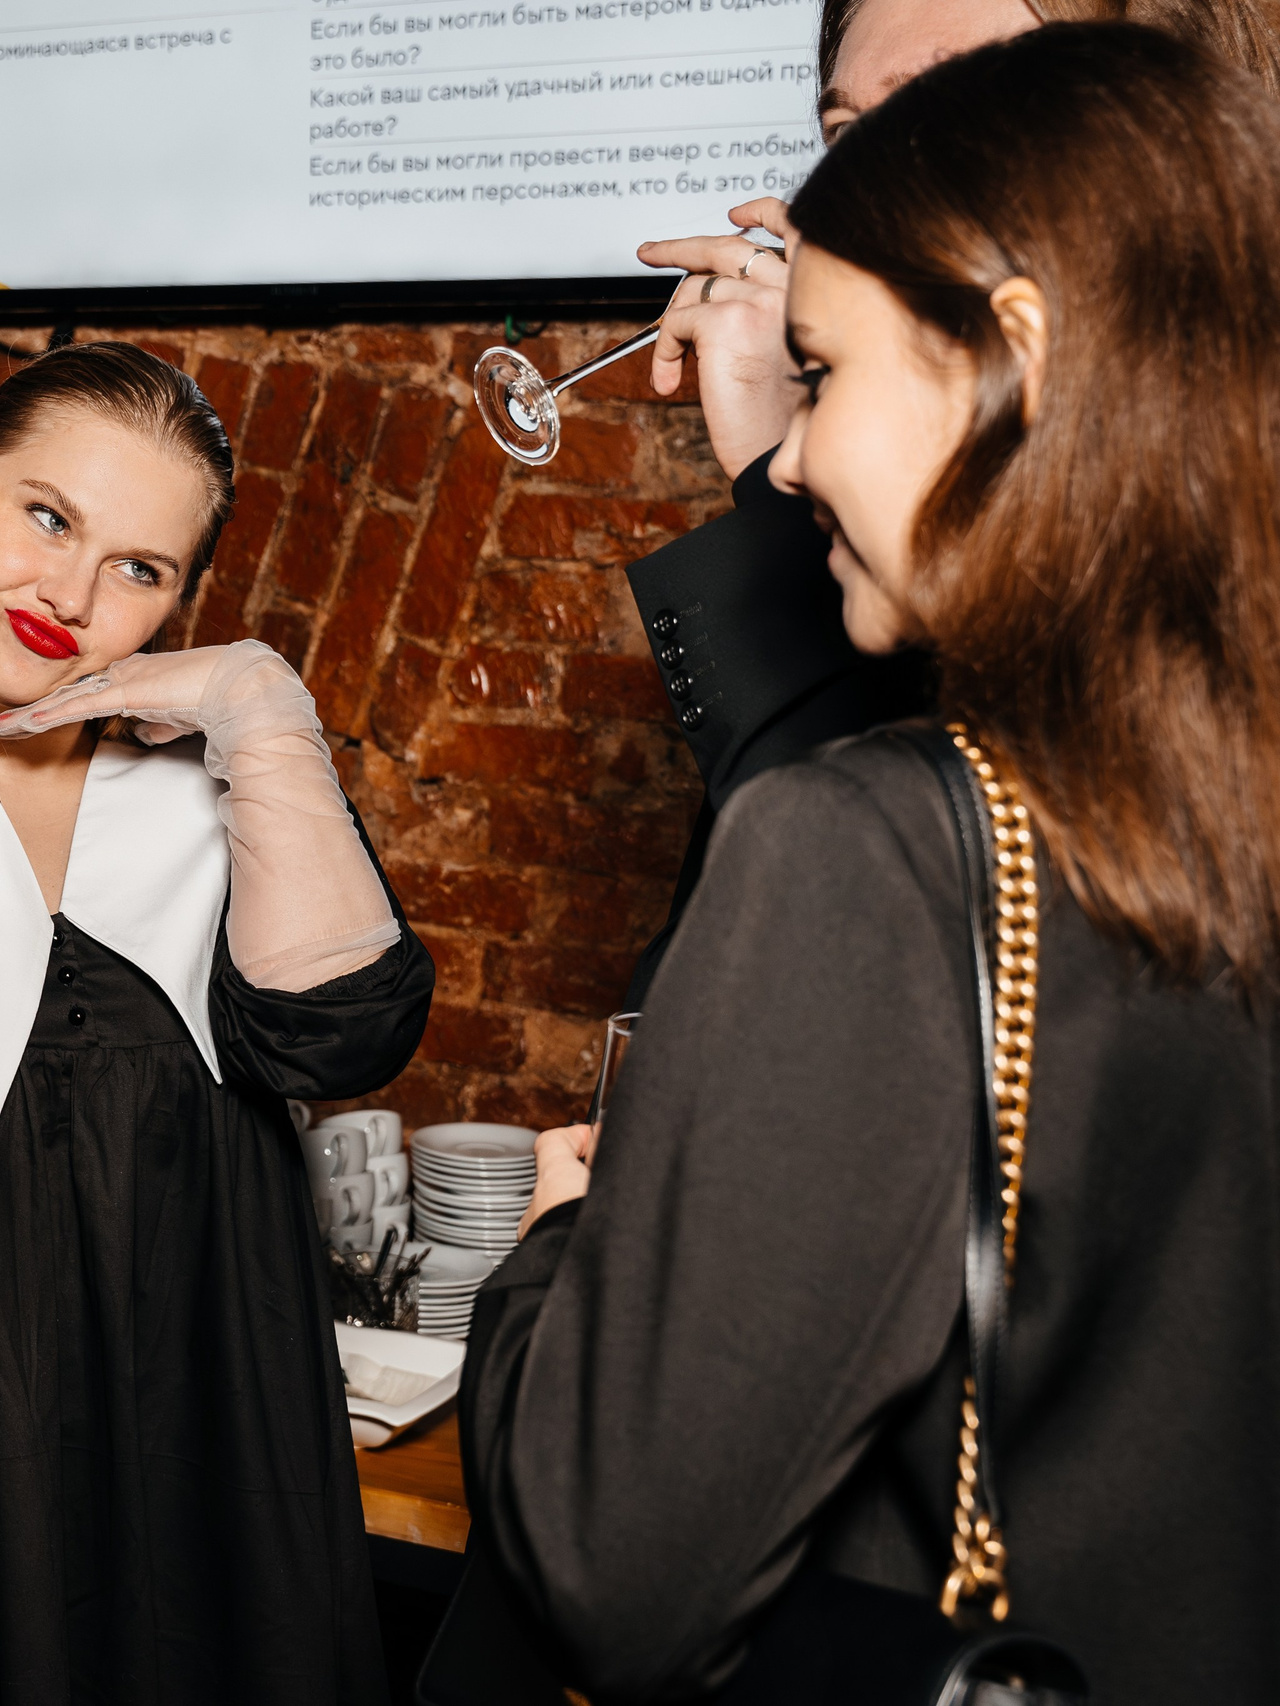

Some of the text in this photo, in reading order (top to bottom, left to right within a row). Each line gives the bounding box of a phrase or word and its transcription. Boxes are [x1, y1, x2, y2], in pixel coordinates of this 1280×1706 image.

[311, 19, 364, 40] Если
[369, 14, 398, 35] бы
[405, 17, 432, 33] вы
[439, 11, 507, 30] могли
[512, 4, 569, 25] быть
[575, 0, 693, 20] мастером
[700, 0, 714, 12] в
[134, 31, 215, 51] встреча
[220, 28, 232, 44] с
[311, 45, 422, 71] это было?
[310, 86, 374, 108] Какой
[381, 87, 422, 104] ваш
[428, 78, 499, 101] самый
[505, 72, 603, 101] удачный
[610, 73, 653, 90] или
[660, 61, 773, 87] смешной
[310, 116, 398, 143] работе?
[310, 133, 815, 176] Если бы вы могли провести вечер с любым
[309, 187, 466, 209] историческим
[472, 181, 623, 205] персонажем,
[629, 178, 668, 195] кто
[675, 171, 708, 193] бы
[715, 175, 756, 192] это
